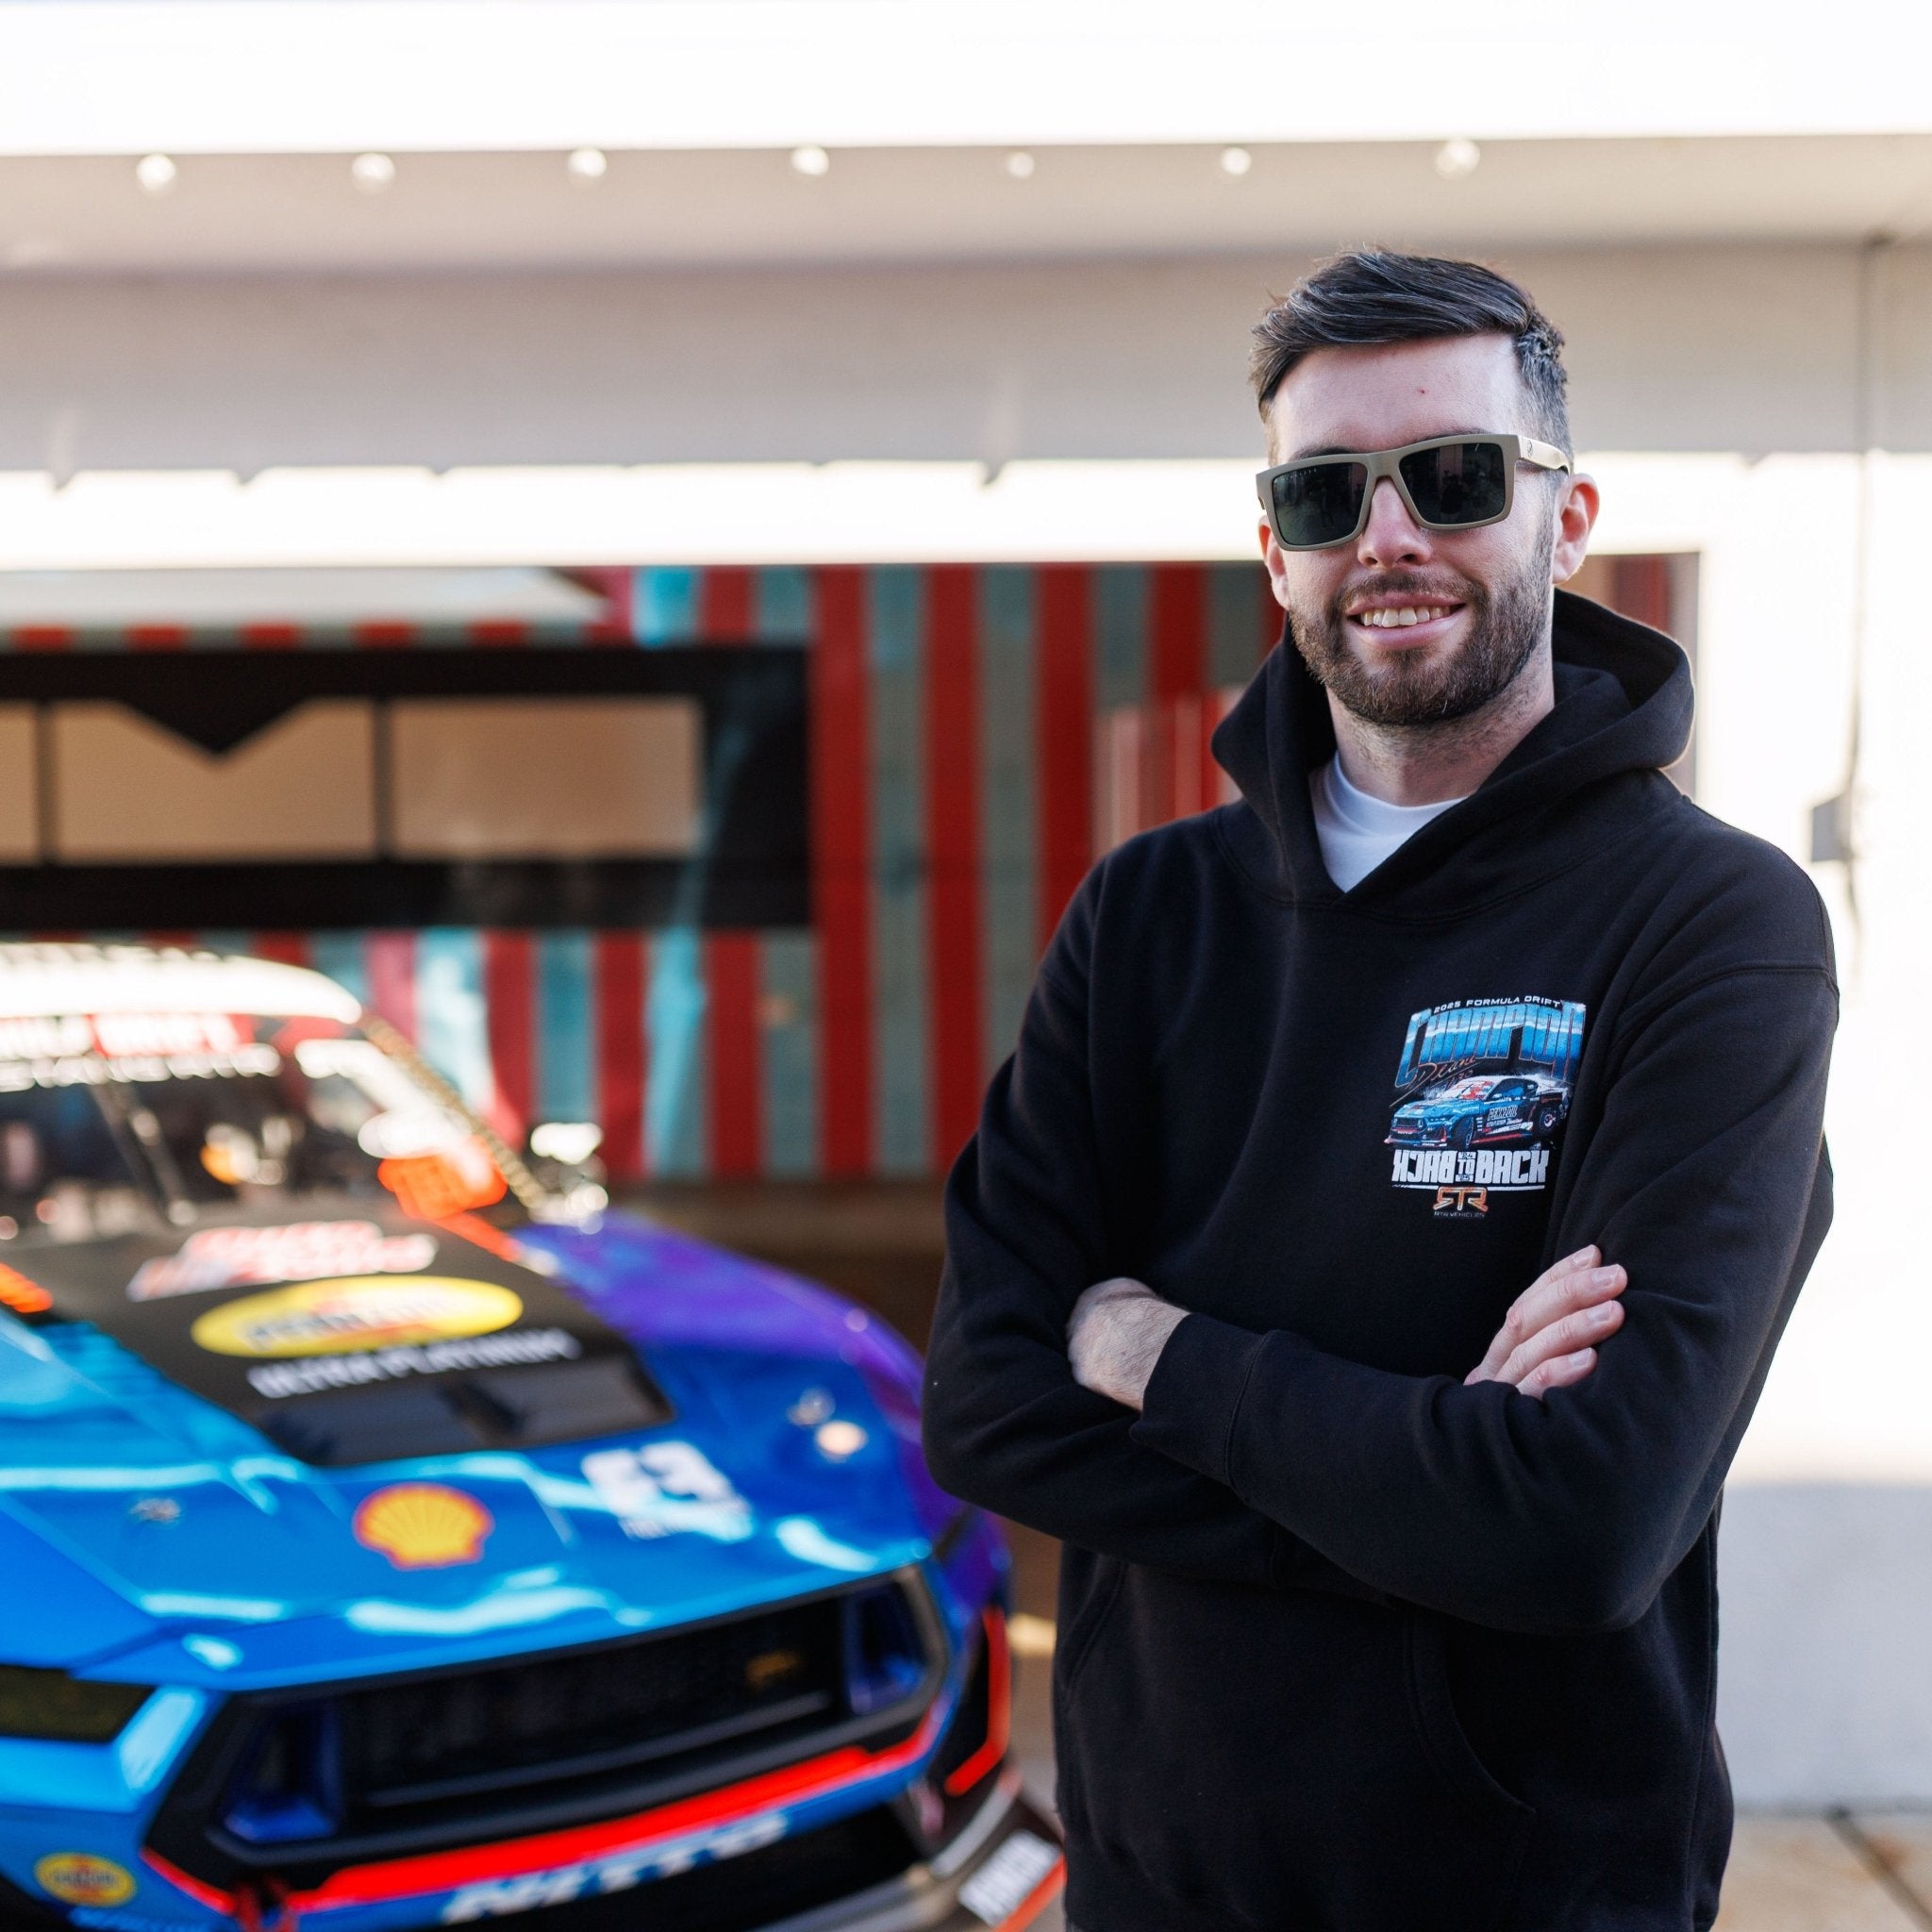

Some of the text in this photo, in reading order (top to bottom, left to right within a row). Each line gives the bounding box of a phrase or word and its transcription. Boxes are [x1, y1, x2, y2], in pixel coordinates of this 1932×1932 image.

[1433, 995, 1561, 1014] 2025 FORMULA DRIFT
[1395, 1000, 1587, 1088] CHAMPION
[1457, 1149, 1550, 1184] TO BACK
[1433, 1186, 1489, 1212] RTR
